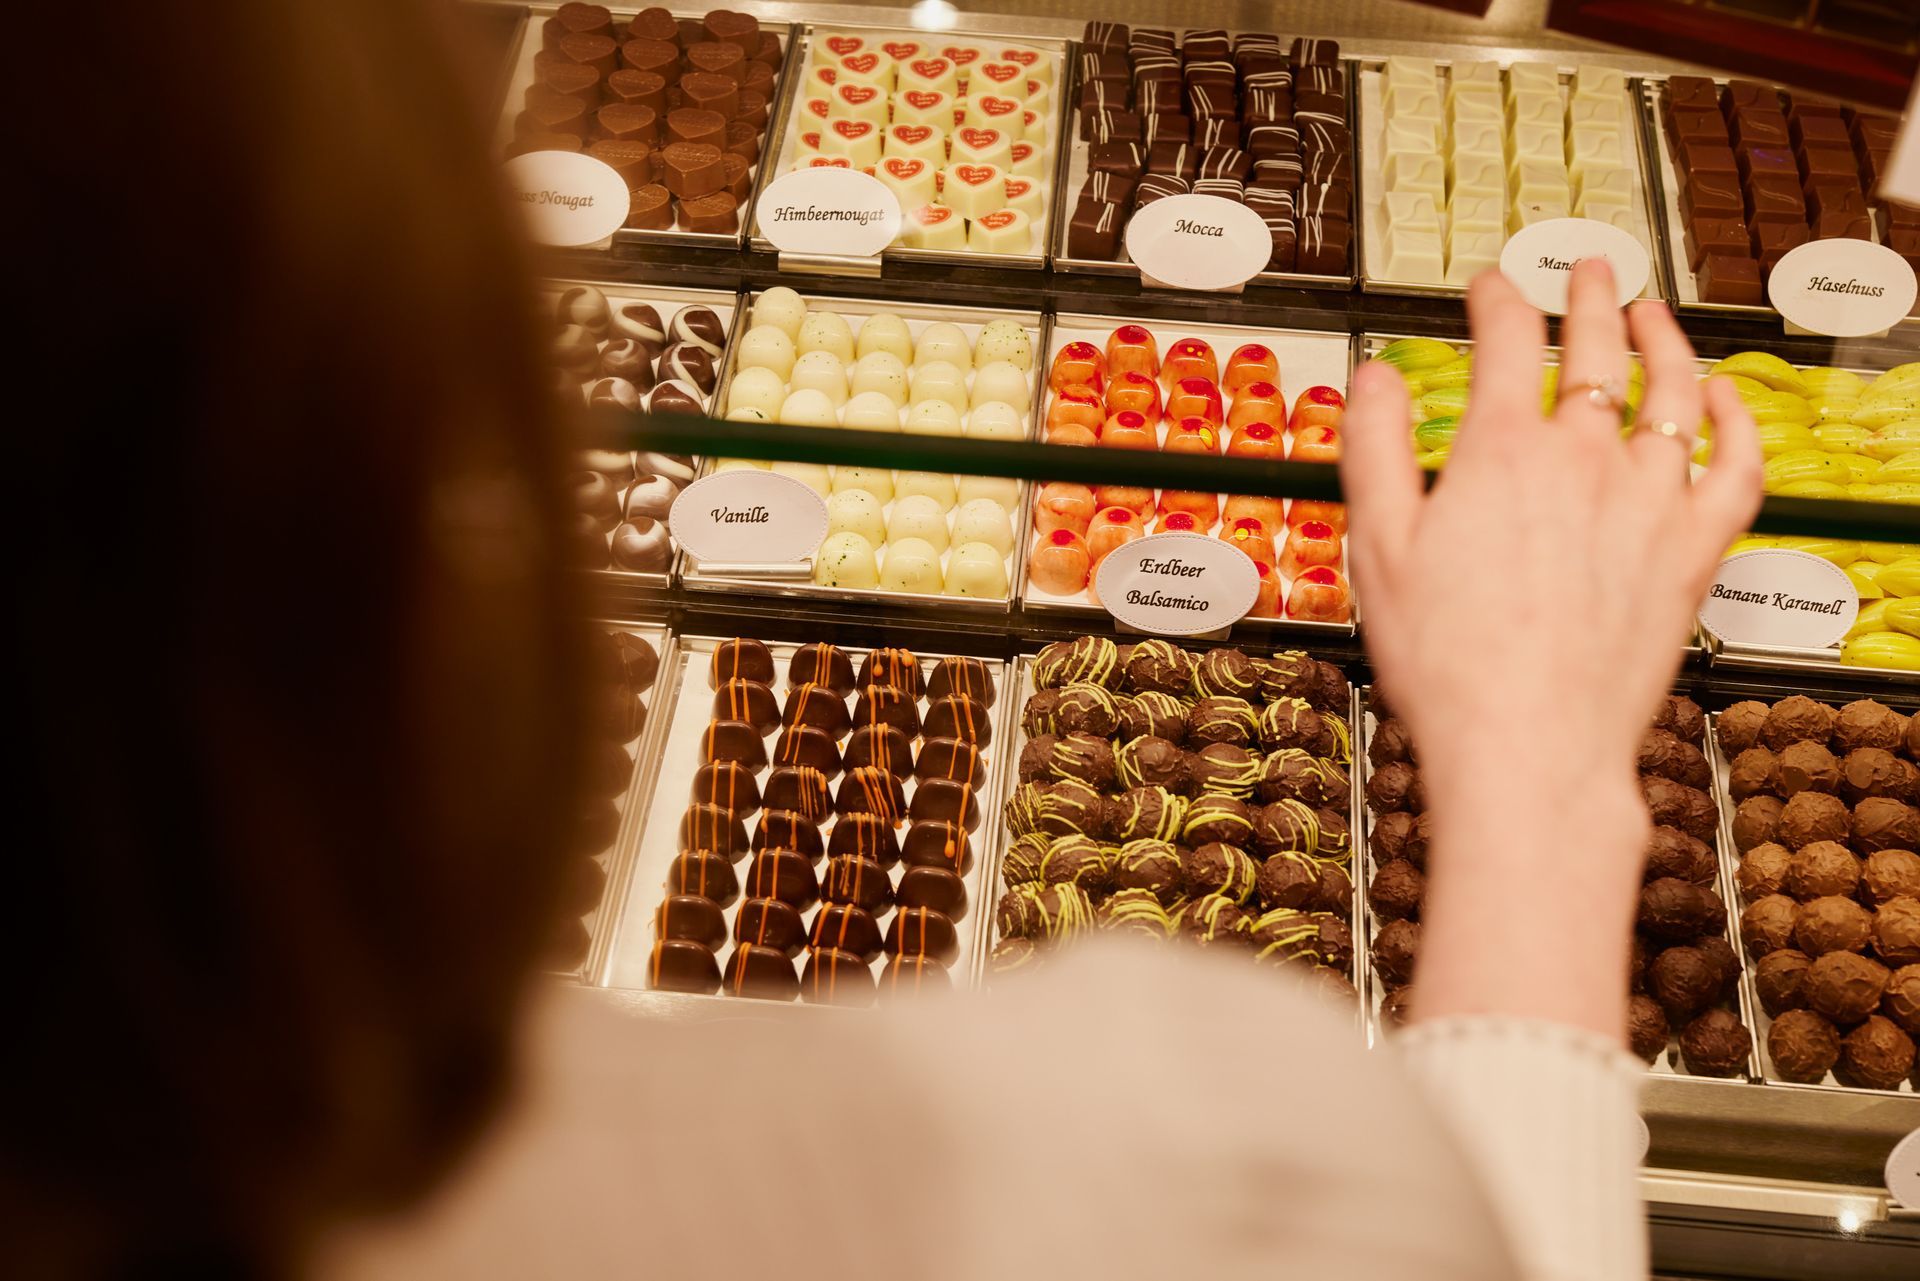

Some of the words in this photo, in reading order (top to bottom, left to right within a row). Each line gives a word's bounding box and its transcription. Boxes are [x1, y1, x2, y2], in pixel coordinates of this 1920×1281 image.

[539, 190, 595, 212] Nougat
[774, 205, 885, 226] Himbeernougat
[1174, 219, 1224, 237] Mocca
[1537, 256, 1584, 272] Mand
[1807, 276, 1885, 298] Haselnuss
[710, 506, 769, 523] Vanille
[1139, 558, 1206, 578] Erdbeer
[1126, 590, 1209, 612] Balsamico
[1709, 583, 1769, 605] Banane
[1771, 592, 1847, 616] Karamell
